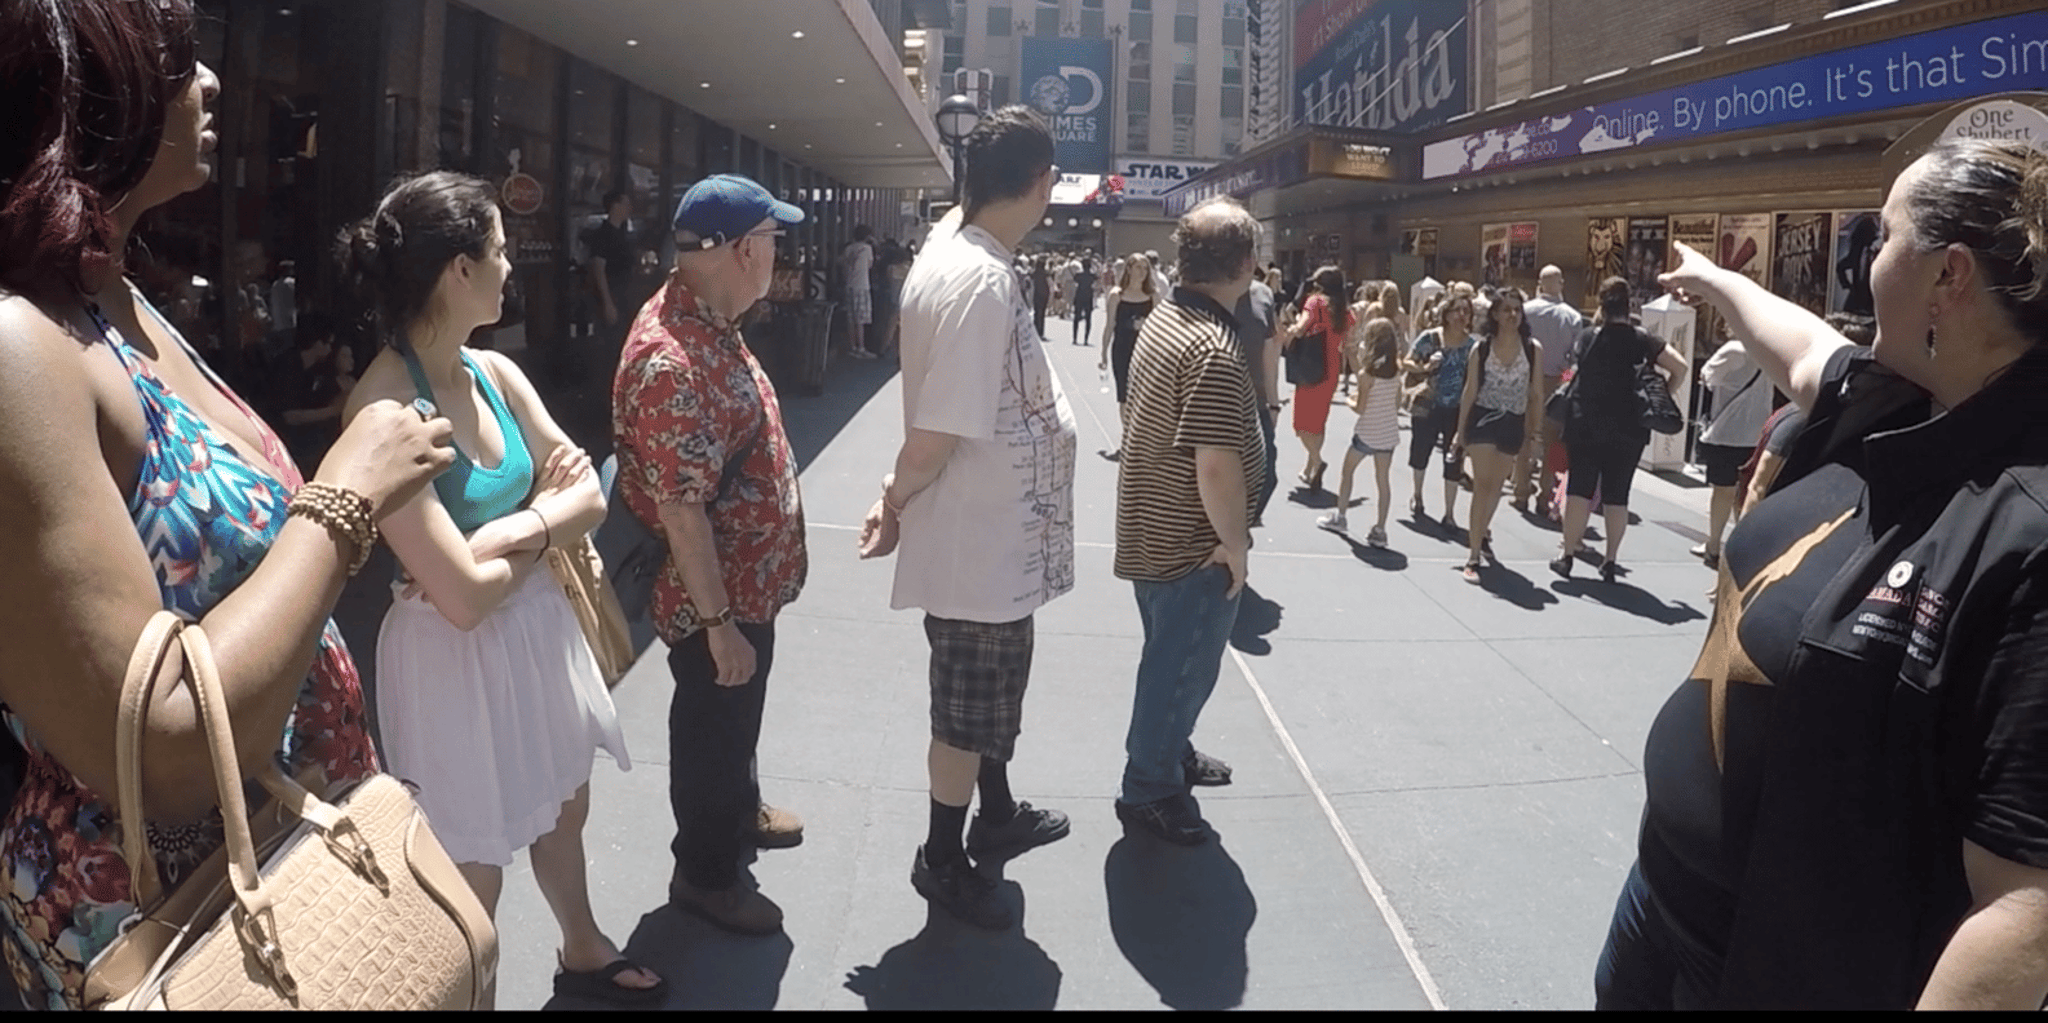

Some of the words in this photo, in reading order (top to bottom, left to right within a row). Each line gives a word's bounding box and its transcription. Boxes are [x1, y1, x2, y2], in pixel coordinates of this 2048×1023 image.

[1302, 13, 1457, 130] Matilda
[1674, 97, 1706, 130] By
[1716, 82, 1813, 126] phone.
[1827, 64, 1873, 103] It's
[1887, 45, 1965, 94] that
[1981, 33, 2048, 79] Sim
[1049, 115, 1097, 131] IMES
[1970, 108, 2014, 129] One
[1053, 130, 1097, 142] UARE
[1956, 125, 2030, 141] Shubert
[1122, 164, 1183, 180] STAR
[1779, 219, 1823, 258] JERSEY
